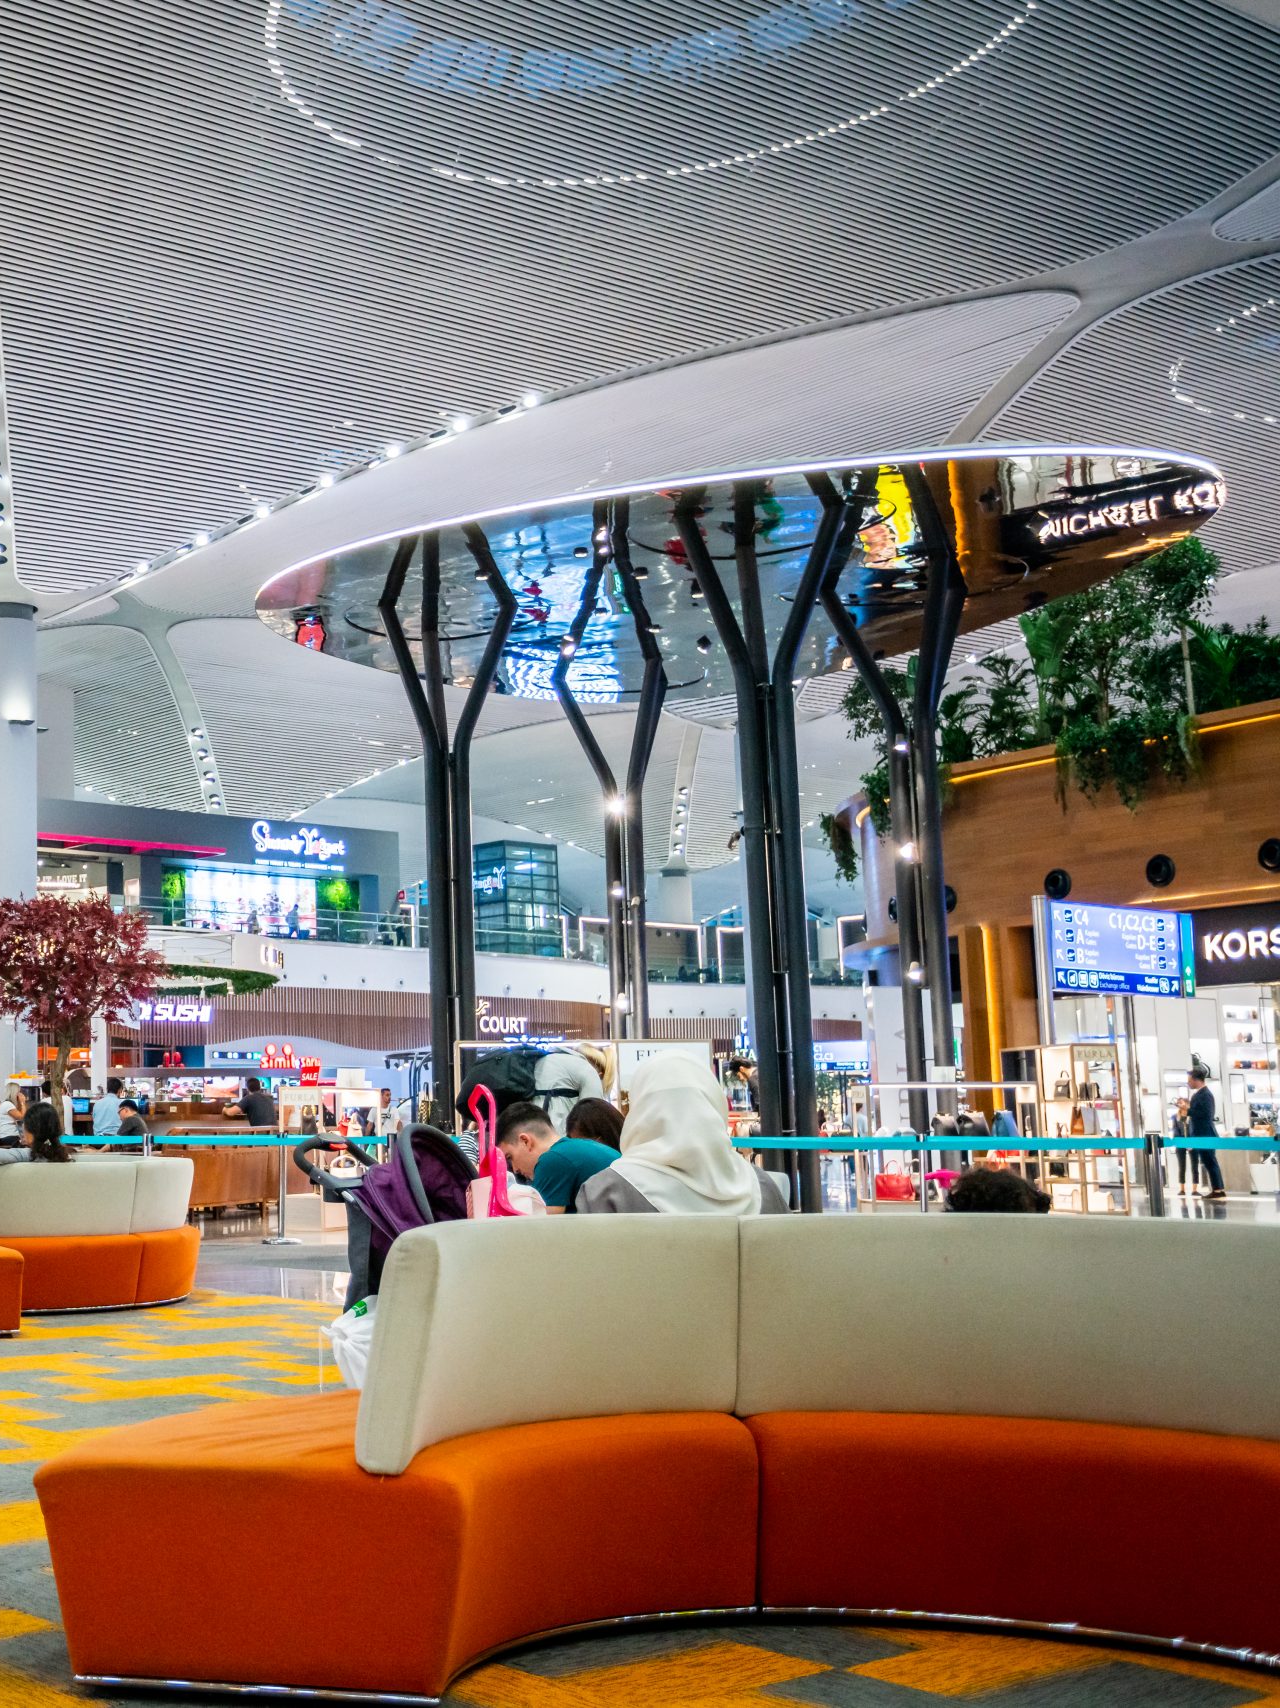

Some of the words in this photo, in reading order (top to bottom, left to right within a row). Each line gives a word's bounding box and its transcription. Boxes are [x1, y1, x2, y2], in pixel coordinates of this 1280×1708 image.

[1074, 909, 1089, 926] C4
[1109, 912, 1156, 934] C1,C2,C3
[1076, 928, 1085, 945] A
[1137, 934, 1157, 951] D-E
[1203, 926, 1280, 962] KORS
[1077, 948, 1085, 964] B
[1150, 954, 1158, 970] F
[154, 1003, 211, 1023] SUSHI
[479, 1016, 528, 1034] COURT
[1076, 1049, 1113, 1058] FURLA
[301, 1072, 318, 1081] SALE
[284, 1093, 316, 1102] FURLA
